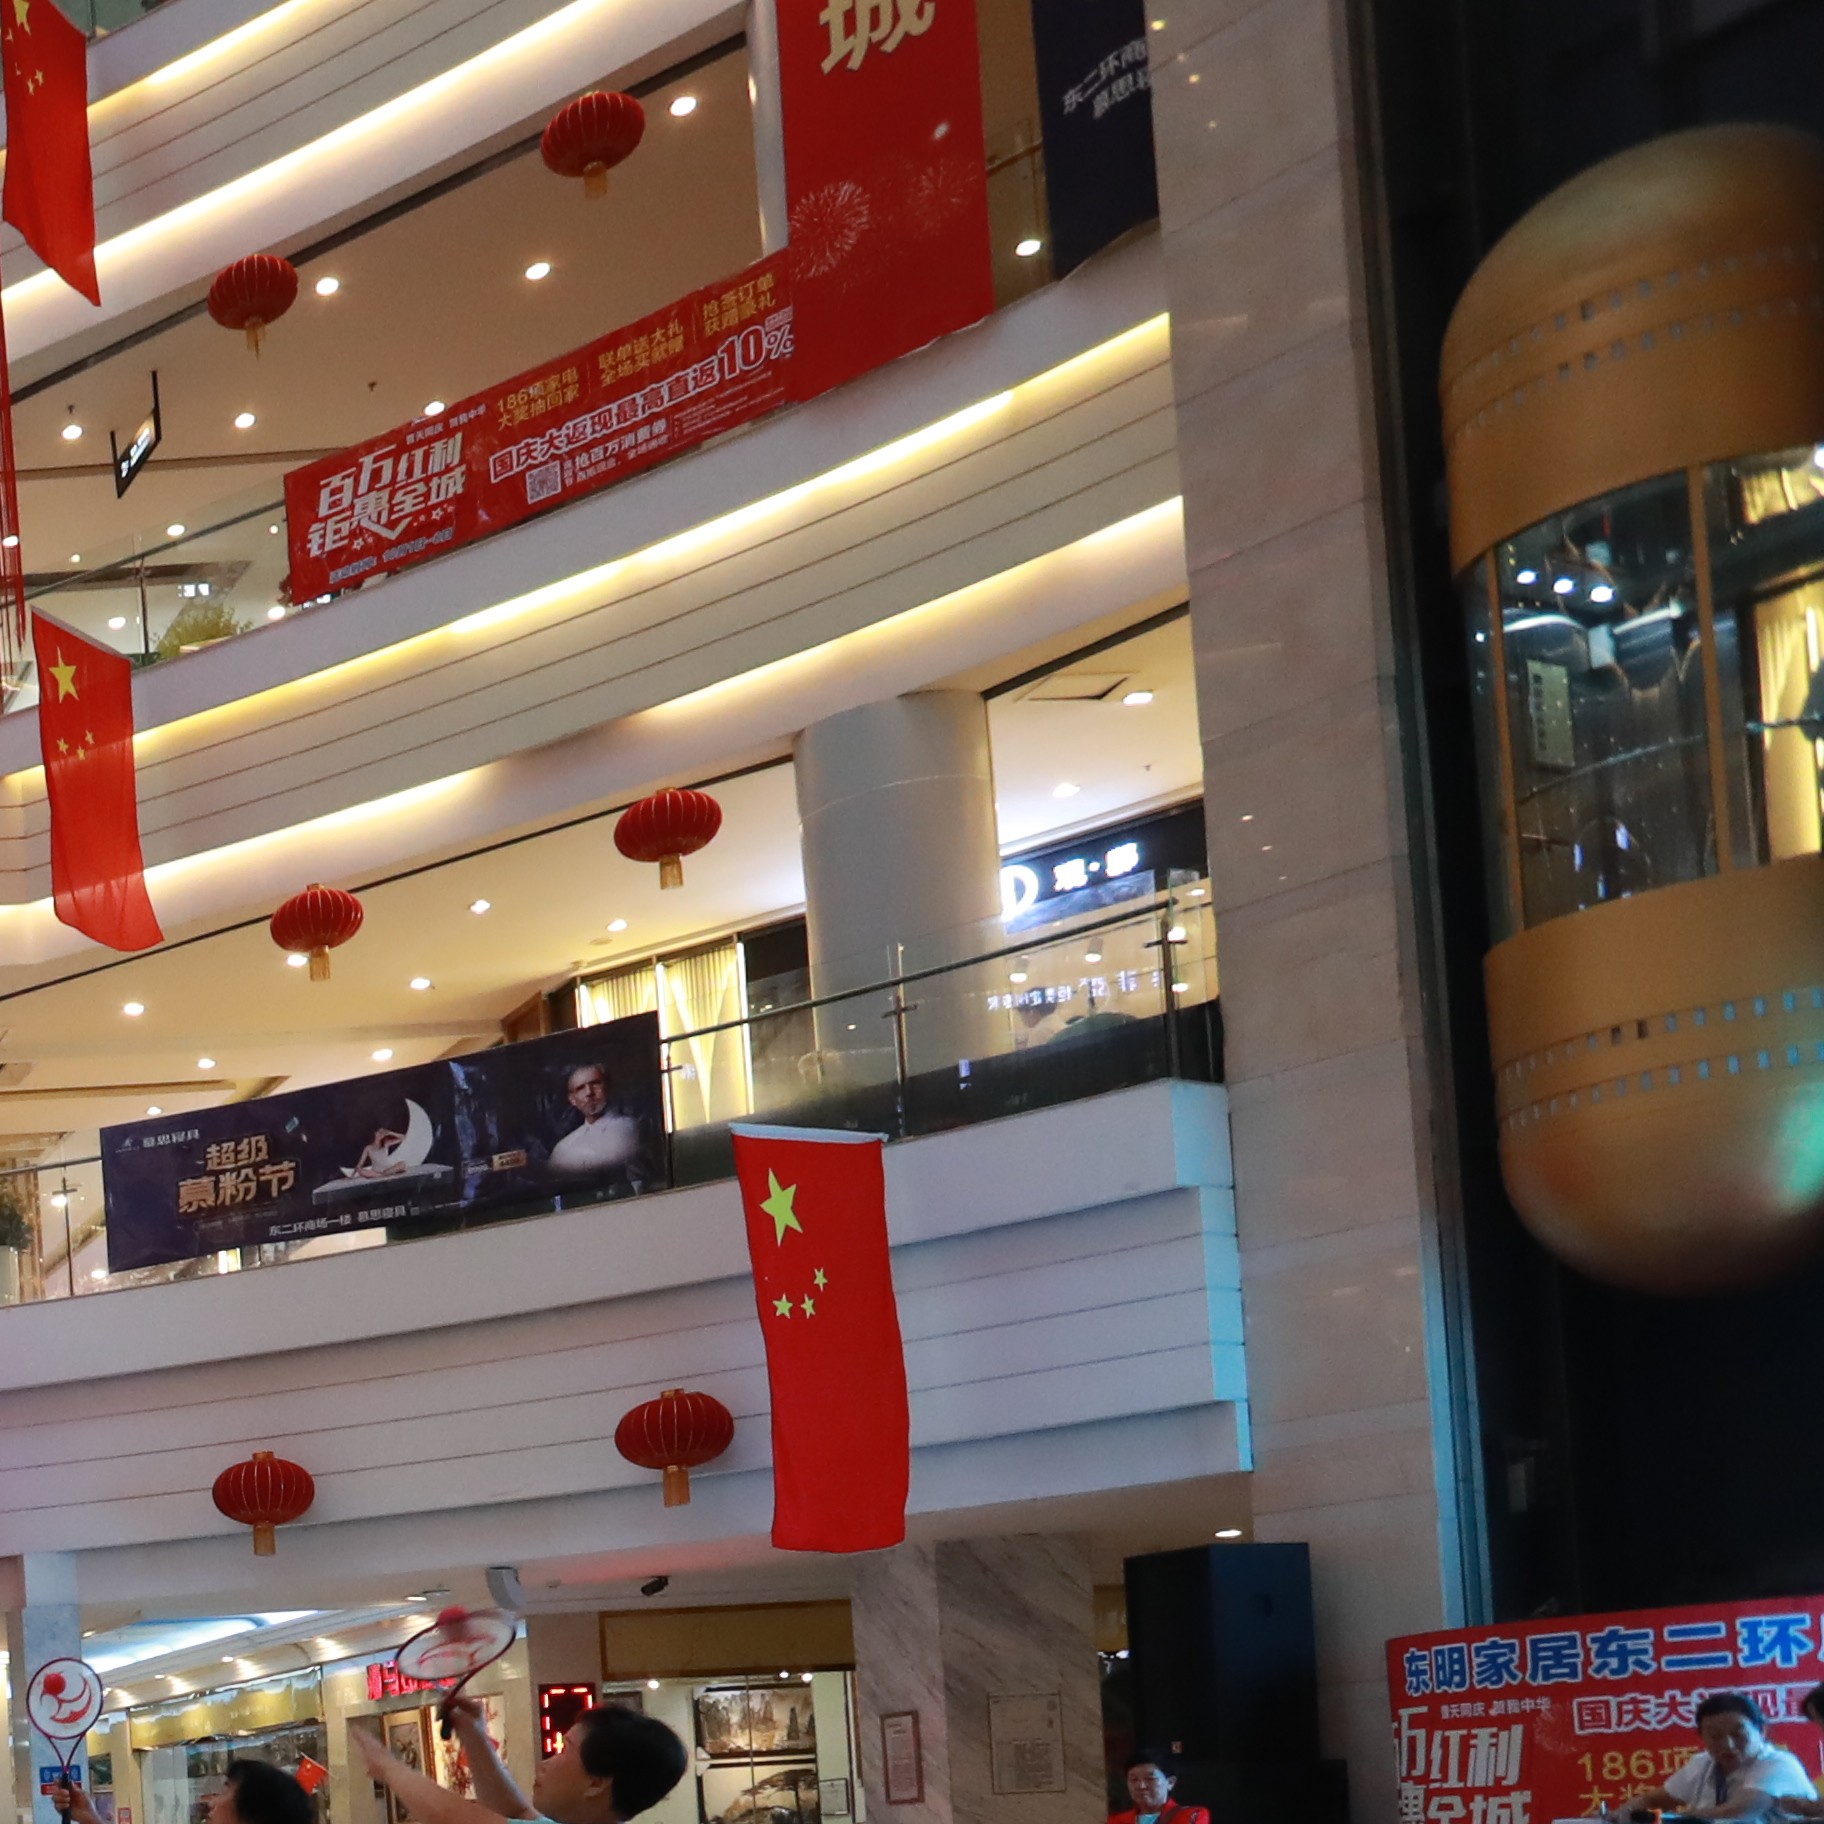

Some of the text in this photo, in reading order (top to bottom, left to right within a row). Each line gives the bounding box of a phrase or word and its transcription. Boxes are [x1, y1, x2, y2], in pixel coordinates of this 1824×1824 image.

[206, 1134, 270, 1172] 超级
[178, 1160, 298, 1214] 慕粉节
[1403, 1611, 1824, 1697] 东明家居东二环
